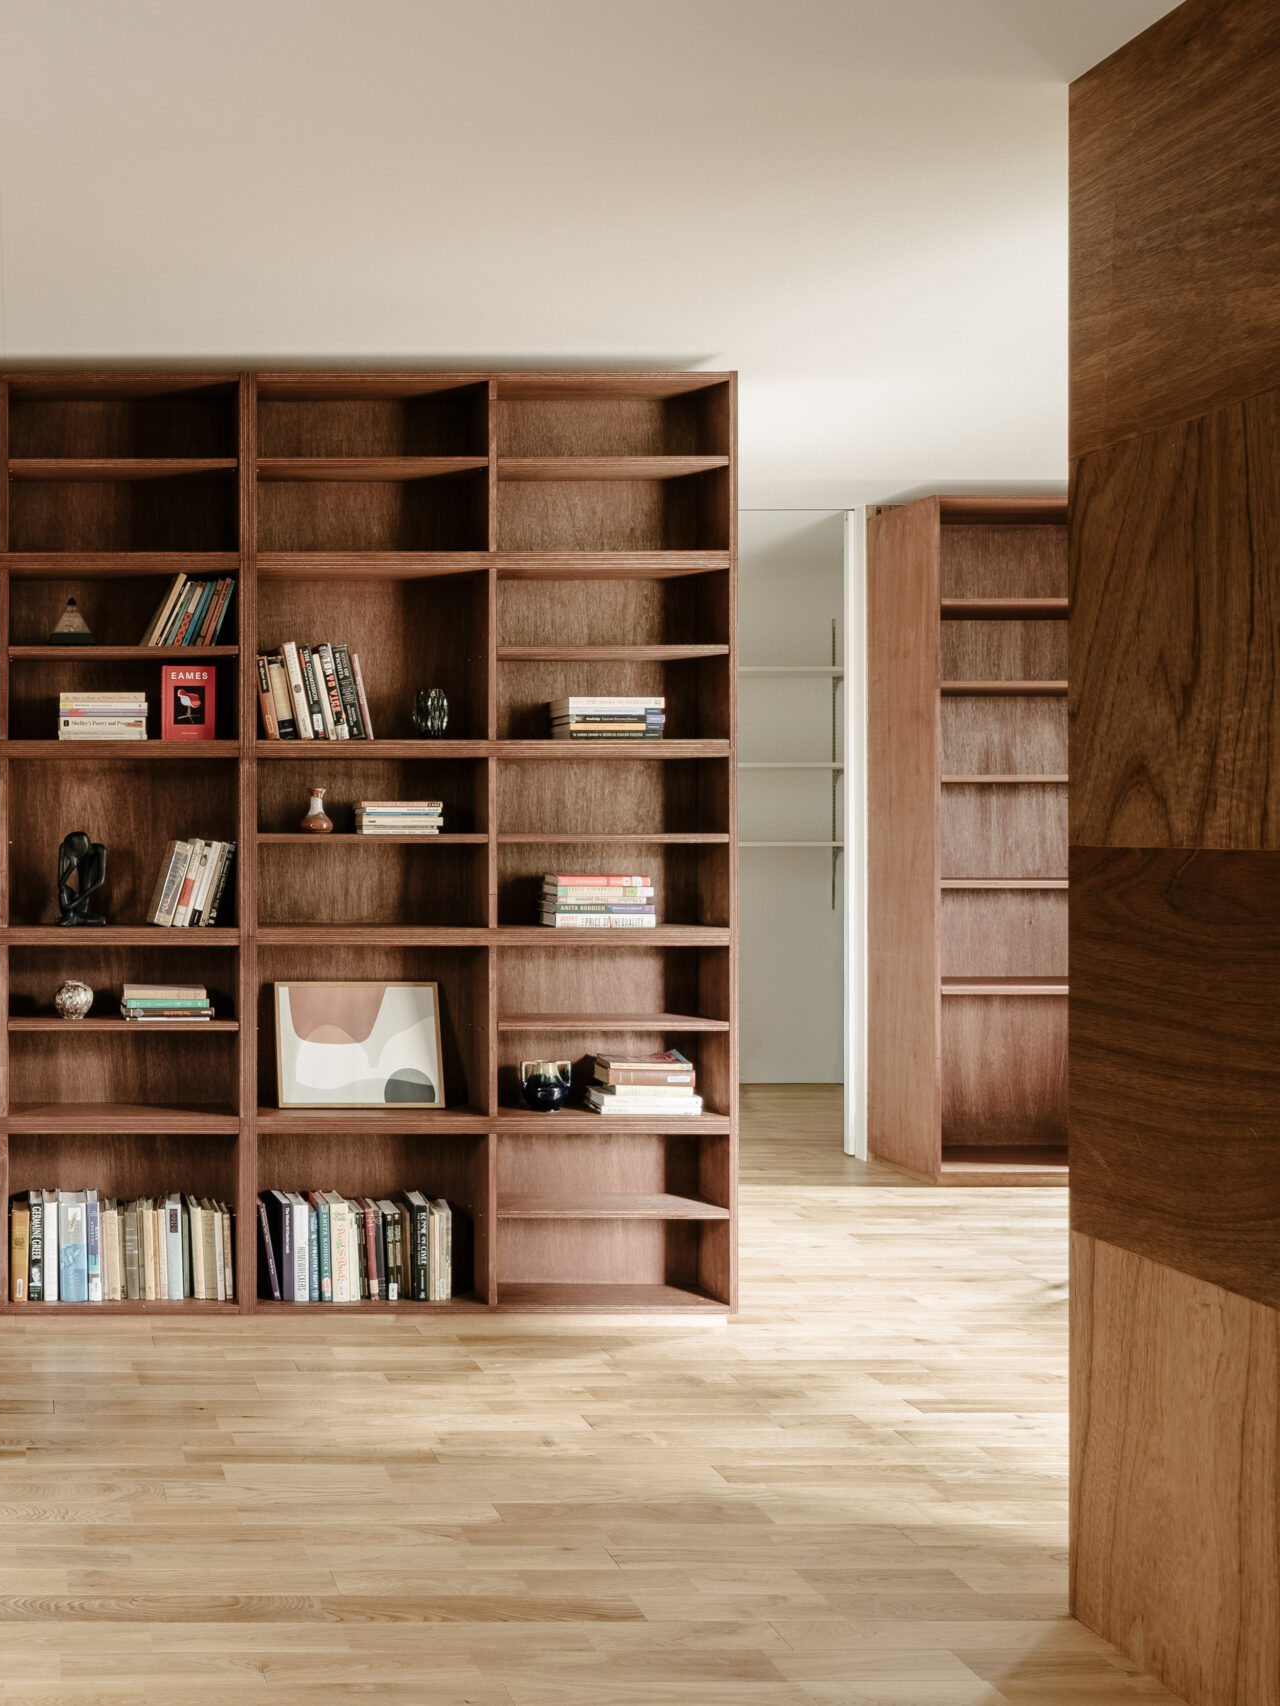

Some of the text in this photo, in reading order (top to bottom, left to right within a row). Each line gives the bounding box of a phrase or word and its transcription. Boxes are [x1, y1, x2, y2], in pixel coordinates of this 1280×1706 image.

[170, 671, 209, 680] EAMES
[306, 662, 318, 701] COMMISSION
[322, 657, 341, 712] TOKYO VICE
[335, 652, 344, 678] WICHITA
[343, 668, 350, 677] OF
[31, 1205, 41, 1260] GERMAINE GREER
[321, 1213, 329, 1271] ANITA RODDICK
[297, 1246, 306, 1291] HOMEWRECKERS
